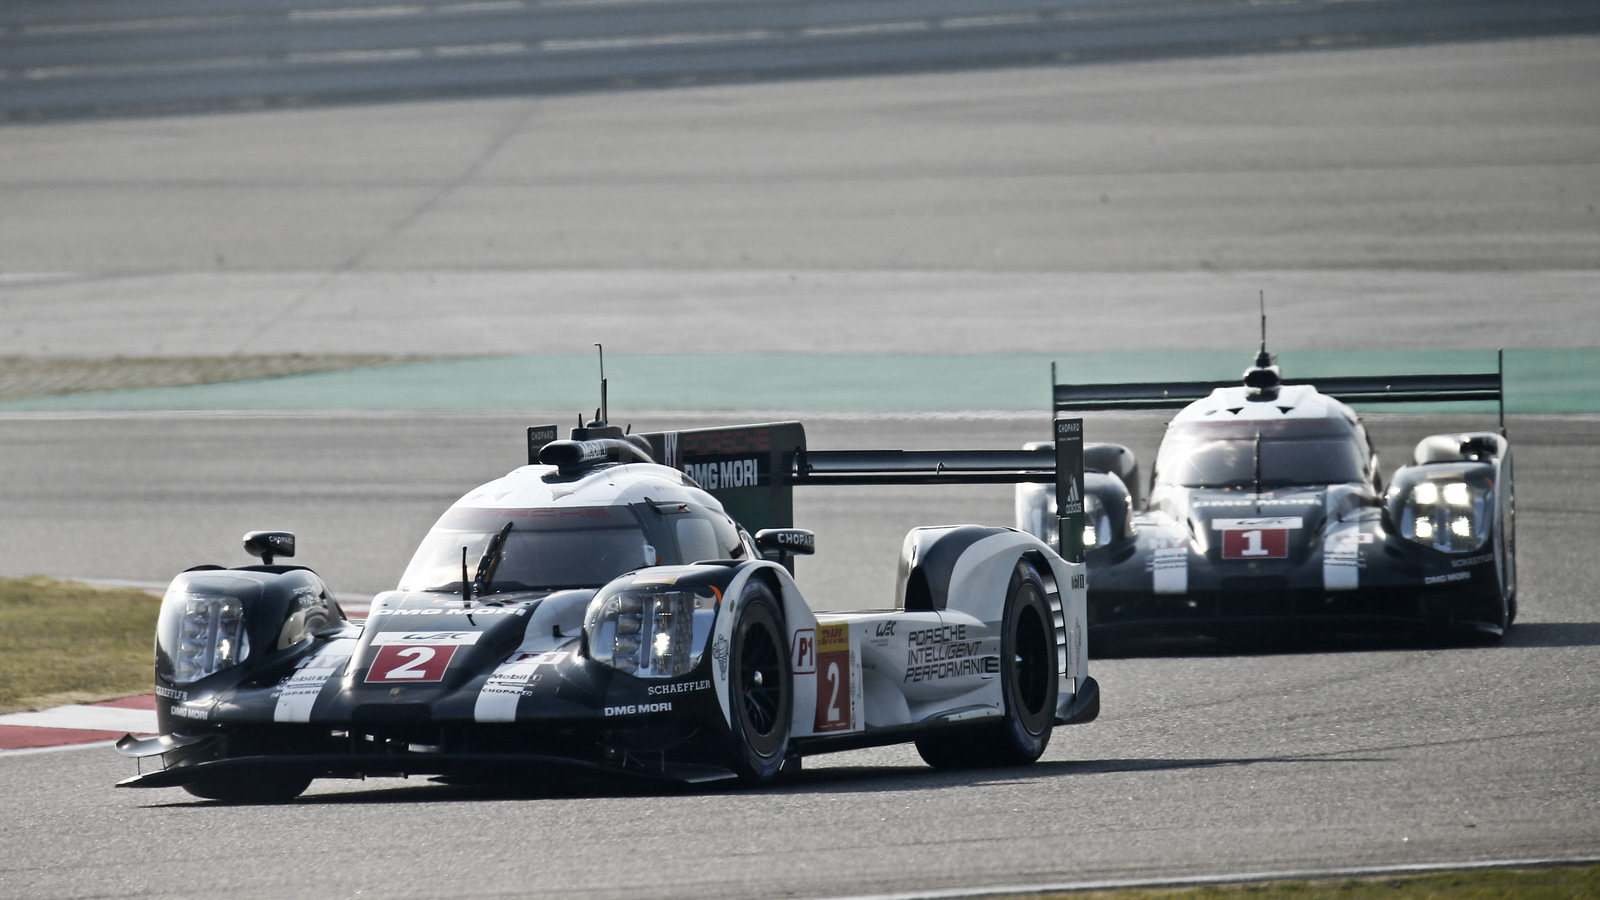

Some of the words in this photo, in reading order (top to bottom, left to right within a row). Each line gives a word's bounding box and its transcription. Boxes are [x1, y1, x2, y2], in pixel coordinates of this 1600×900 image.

[720, 459, 758, 488] MORI
[1241, 530, 1269, 556] 1
[374, 608, 443, 616] DMG
[445, 607, 528, 617] MORI
[402, 632, 468, 641] WEC
[876, 620, 897, 637] WEC
[908, 624, 967, 648] PORSCHE
[384, 646, 437, 680] 2
[797, 637, 814, 666] P1
[907, 640, 983, 666] INTELLIGENT
[648, 680, 711, 696] SCHAEFFLER
[827, 661, 841, 722] 2
[604, 705, 637, 716] DMG
[638, 702, 672, 714] MORI
